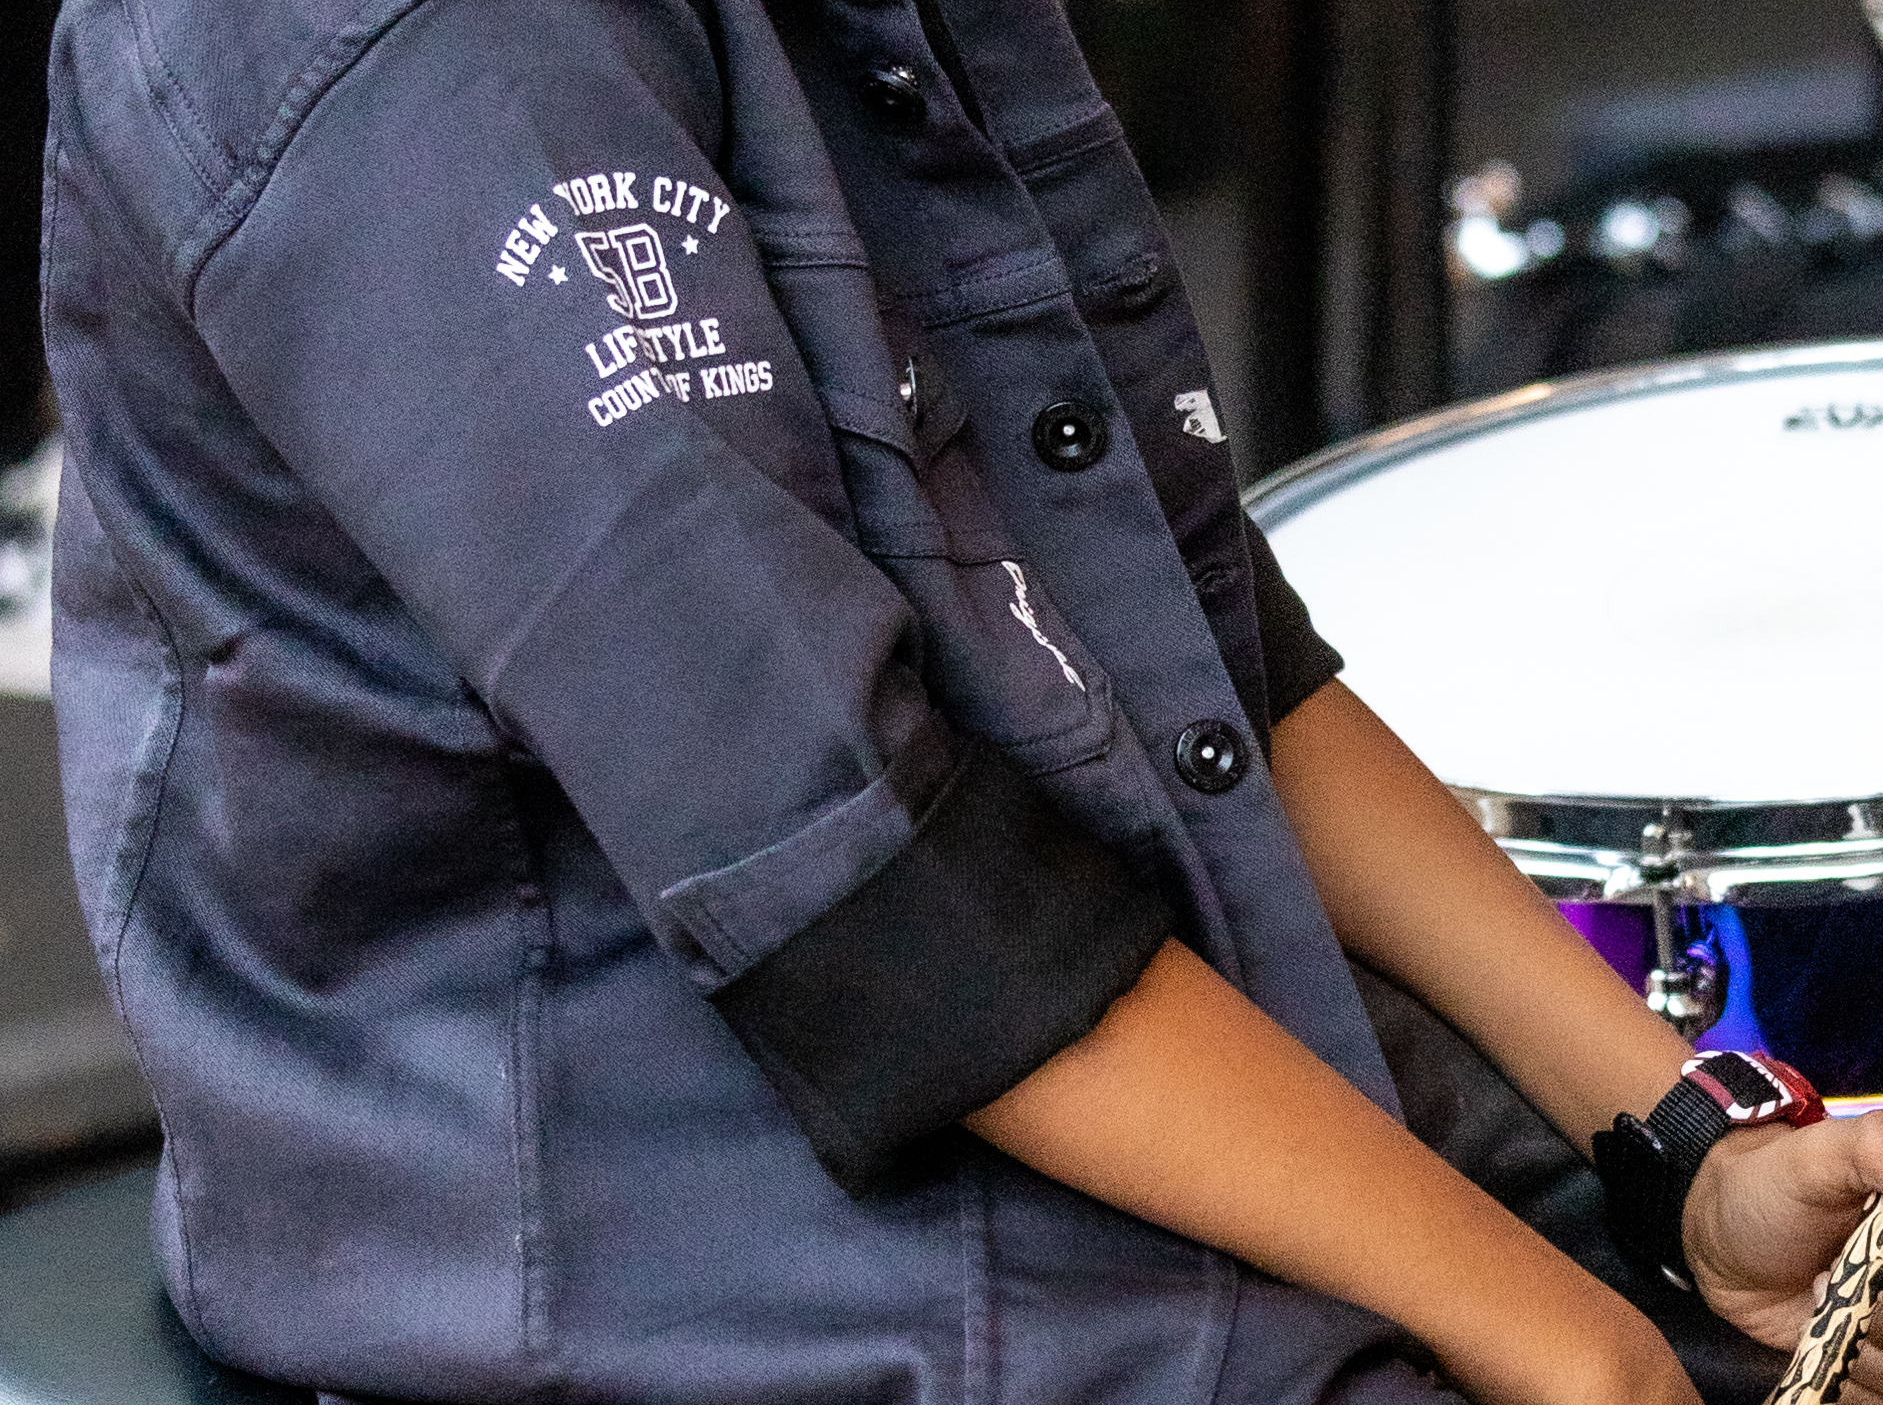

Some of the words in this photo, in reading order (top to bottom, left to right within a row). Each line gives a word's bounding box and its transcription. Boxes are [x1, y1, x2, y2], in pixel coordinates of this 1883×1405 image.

[496, 203, 559, 287] NEW
[552, 171, 640, 216] YORK
[652, 176, 731, 234] CITY
[584, 317, 727, 379] LIFTYLE
[700, 360, 775, 400] KINGS
